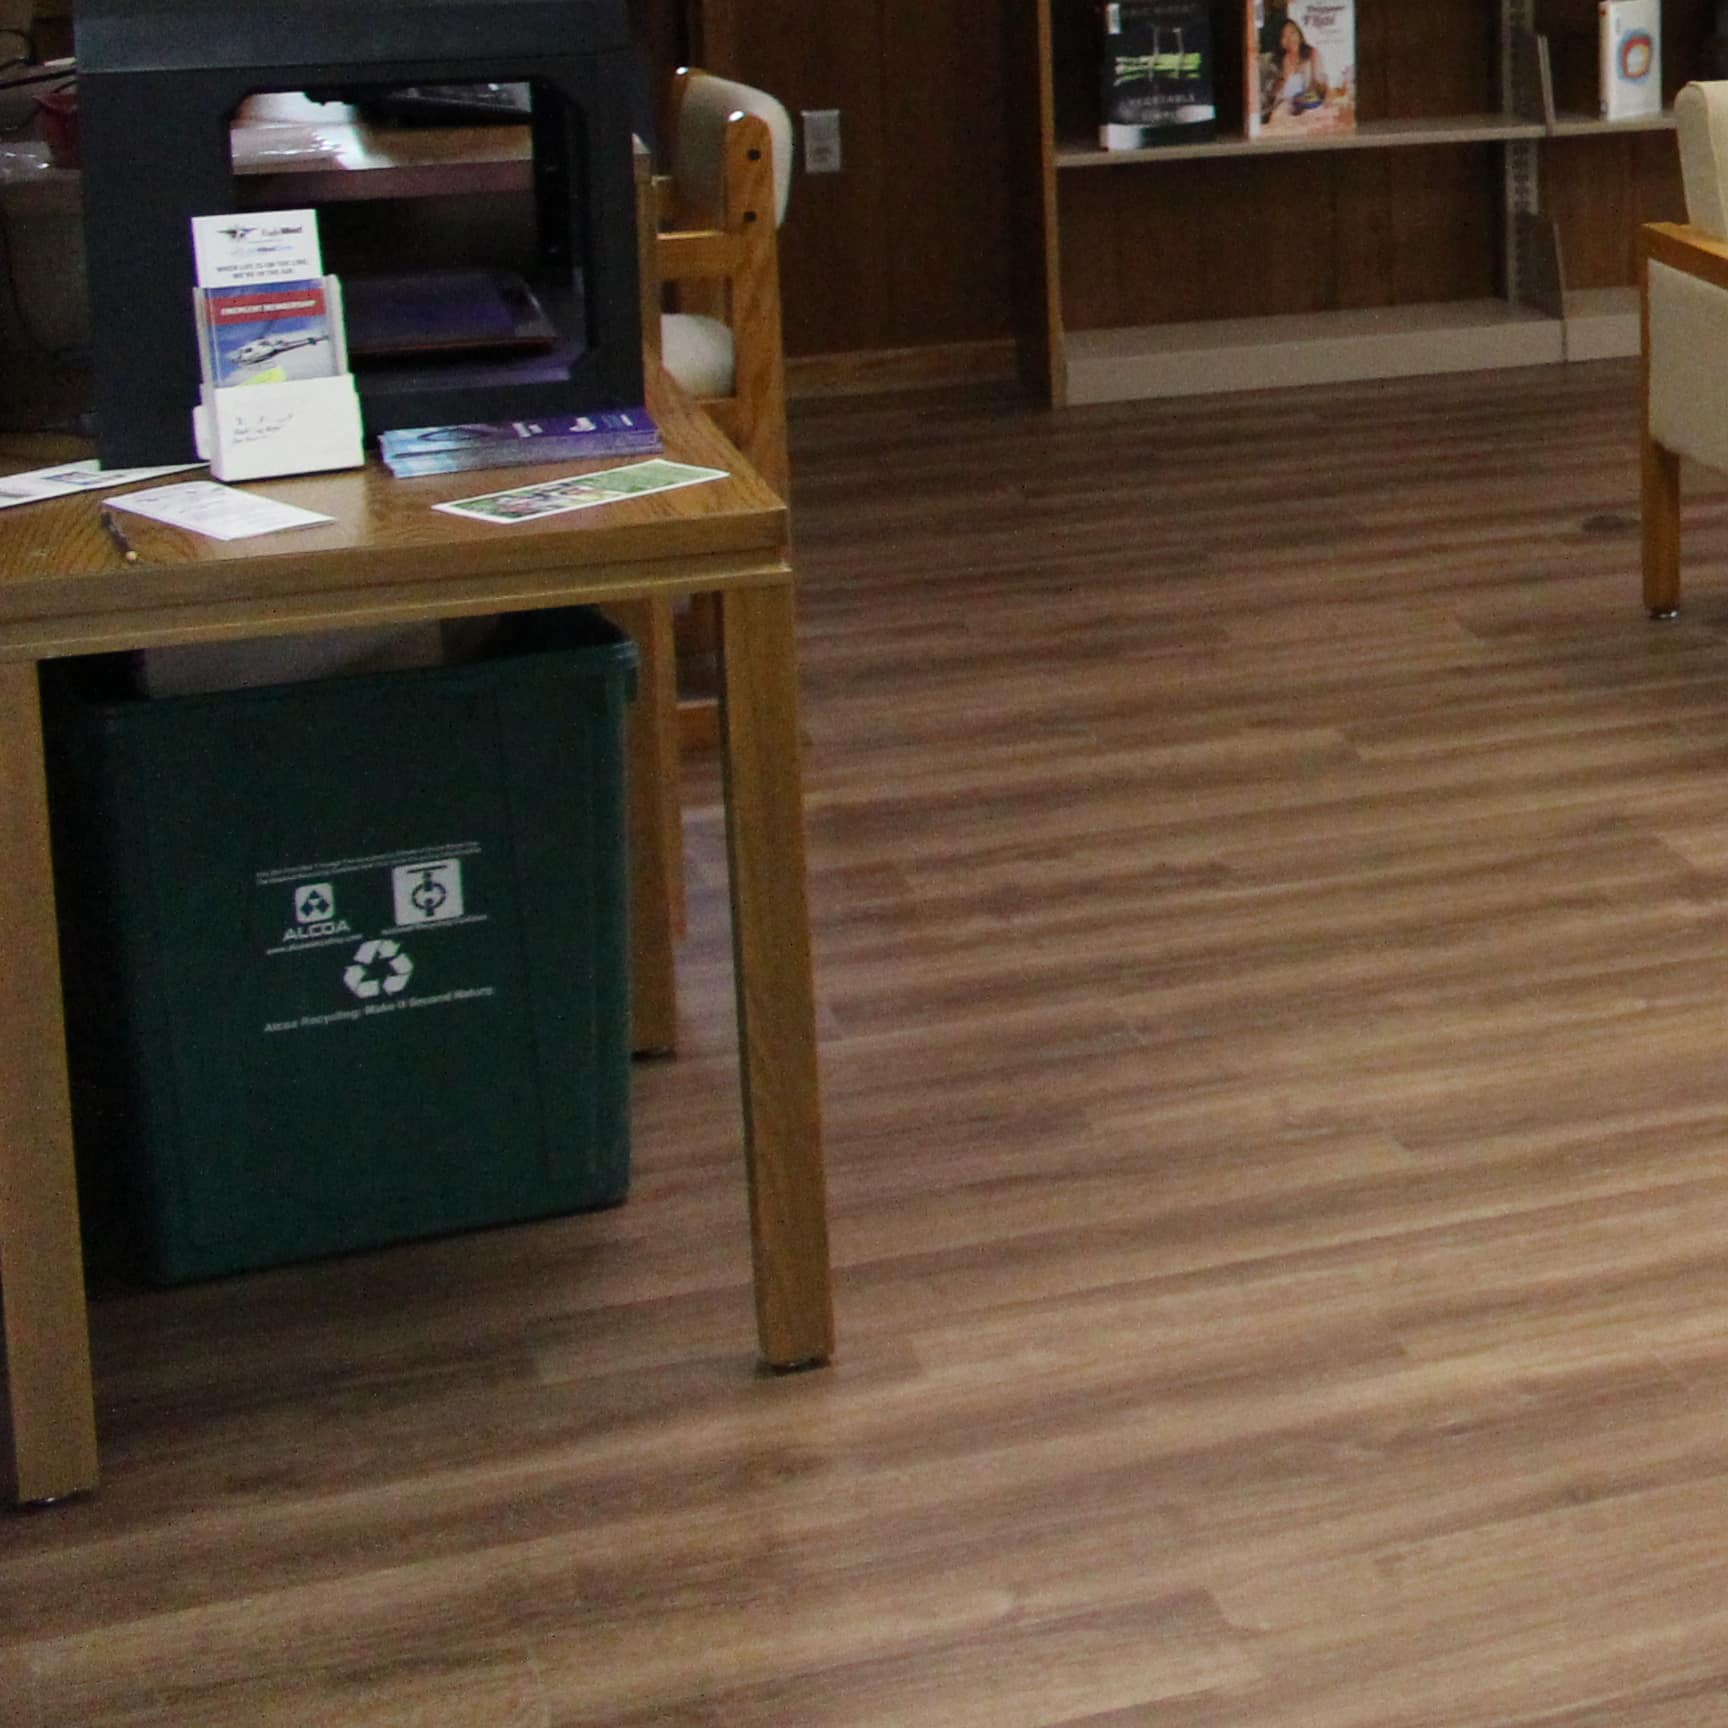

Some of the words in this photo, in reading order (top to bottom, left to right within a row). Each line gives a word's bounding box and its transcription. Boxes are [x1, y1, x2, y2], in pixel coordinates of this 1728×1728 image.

[282, 919, 351, 943] ALCOA
[264, 1018, 298, 1033] Alcoa
[365, 1000, 396, 1016] Make
[409, 991, 452, 1009] Second
